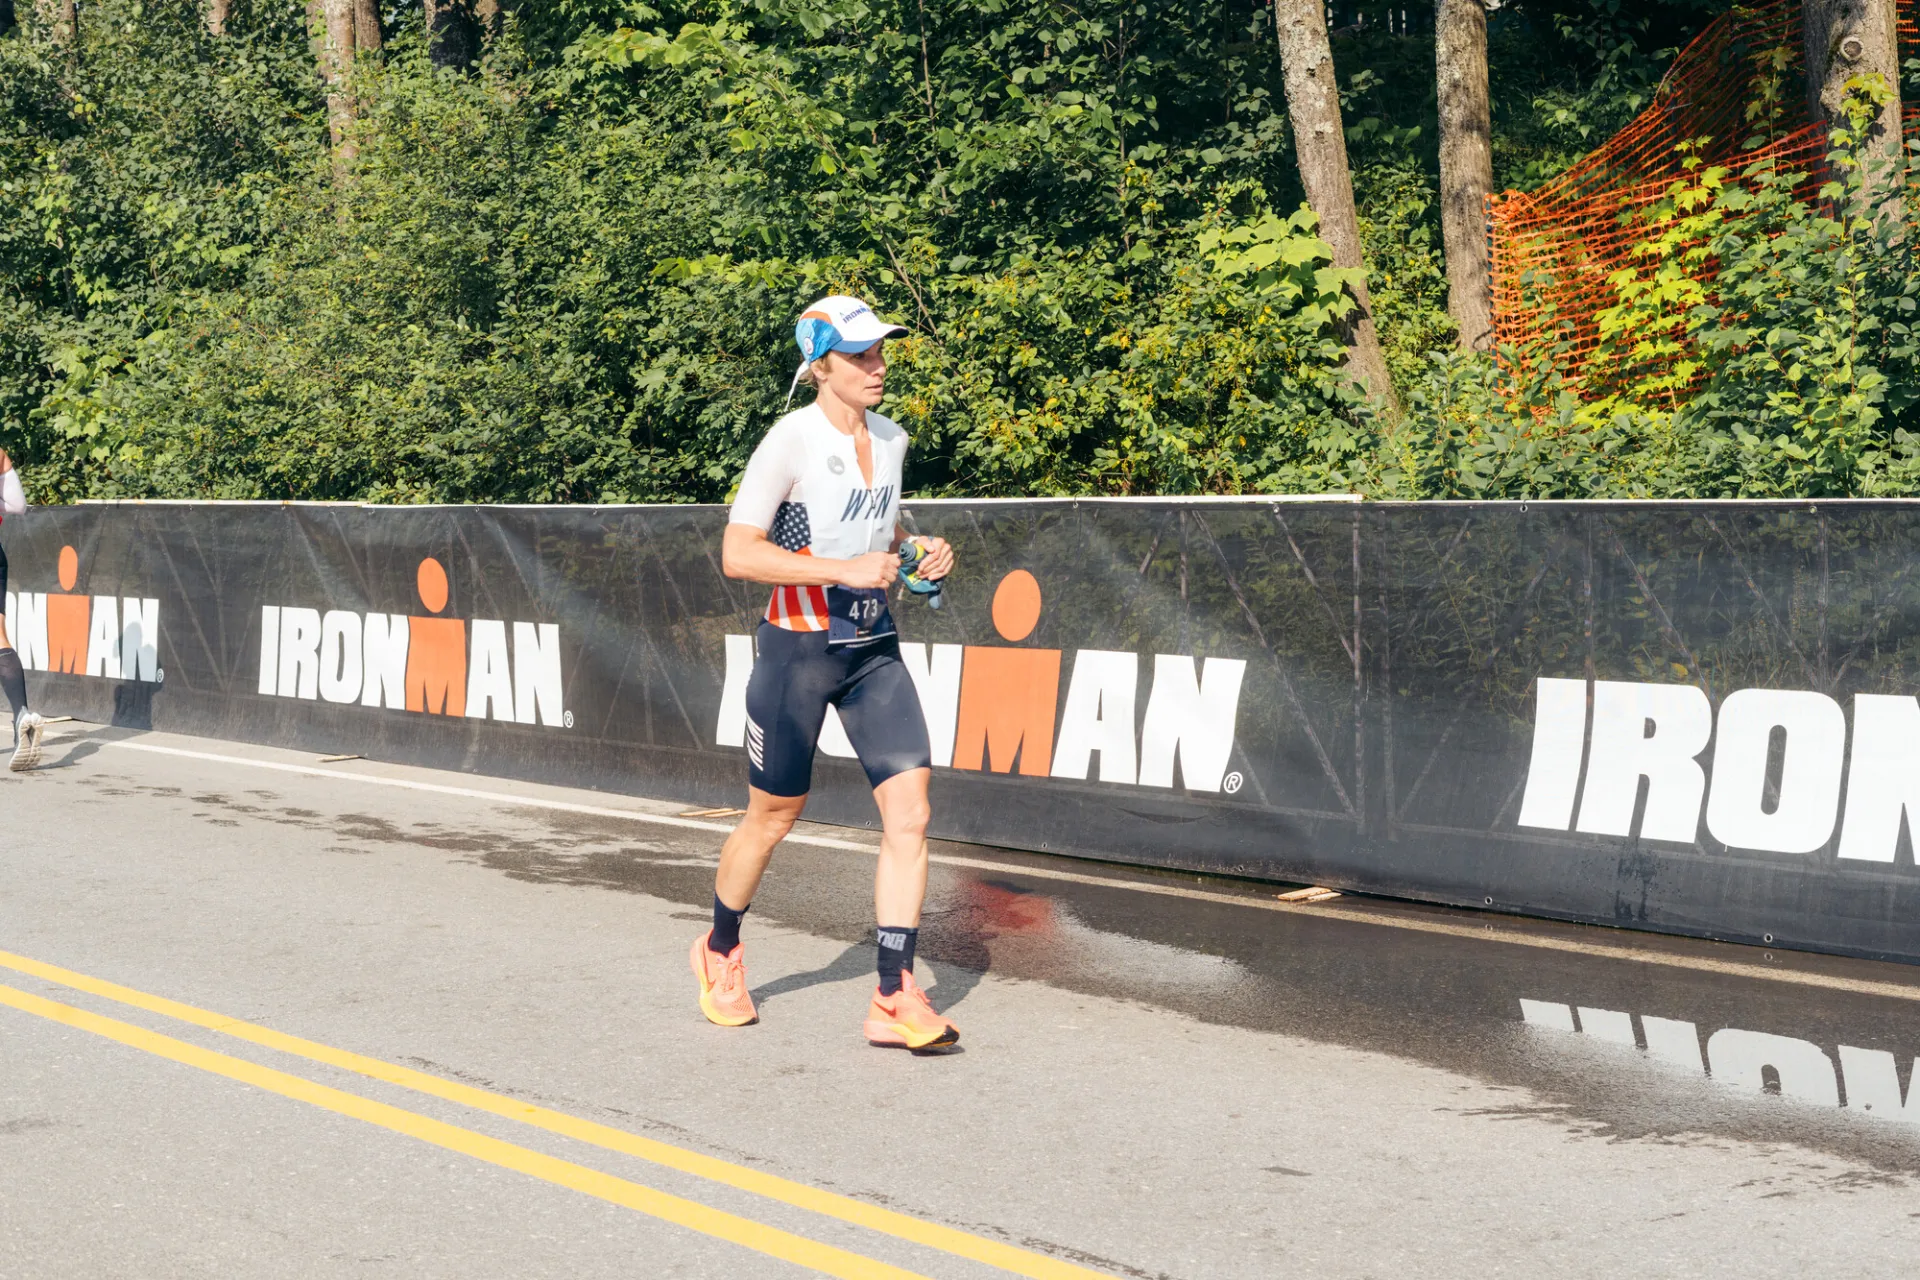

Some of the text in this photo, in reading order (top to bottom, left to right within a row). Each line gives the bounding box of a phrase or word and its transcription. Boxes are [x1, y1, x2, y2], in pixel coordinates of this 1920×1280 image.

[840, 485, 893, 522] WYN
[849, 599, 878, 620] 473
[716, 634, 1247, 793] INMAN
